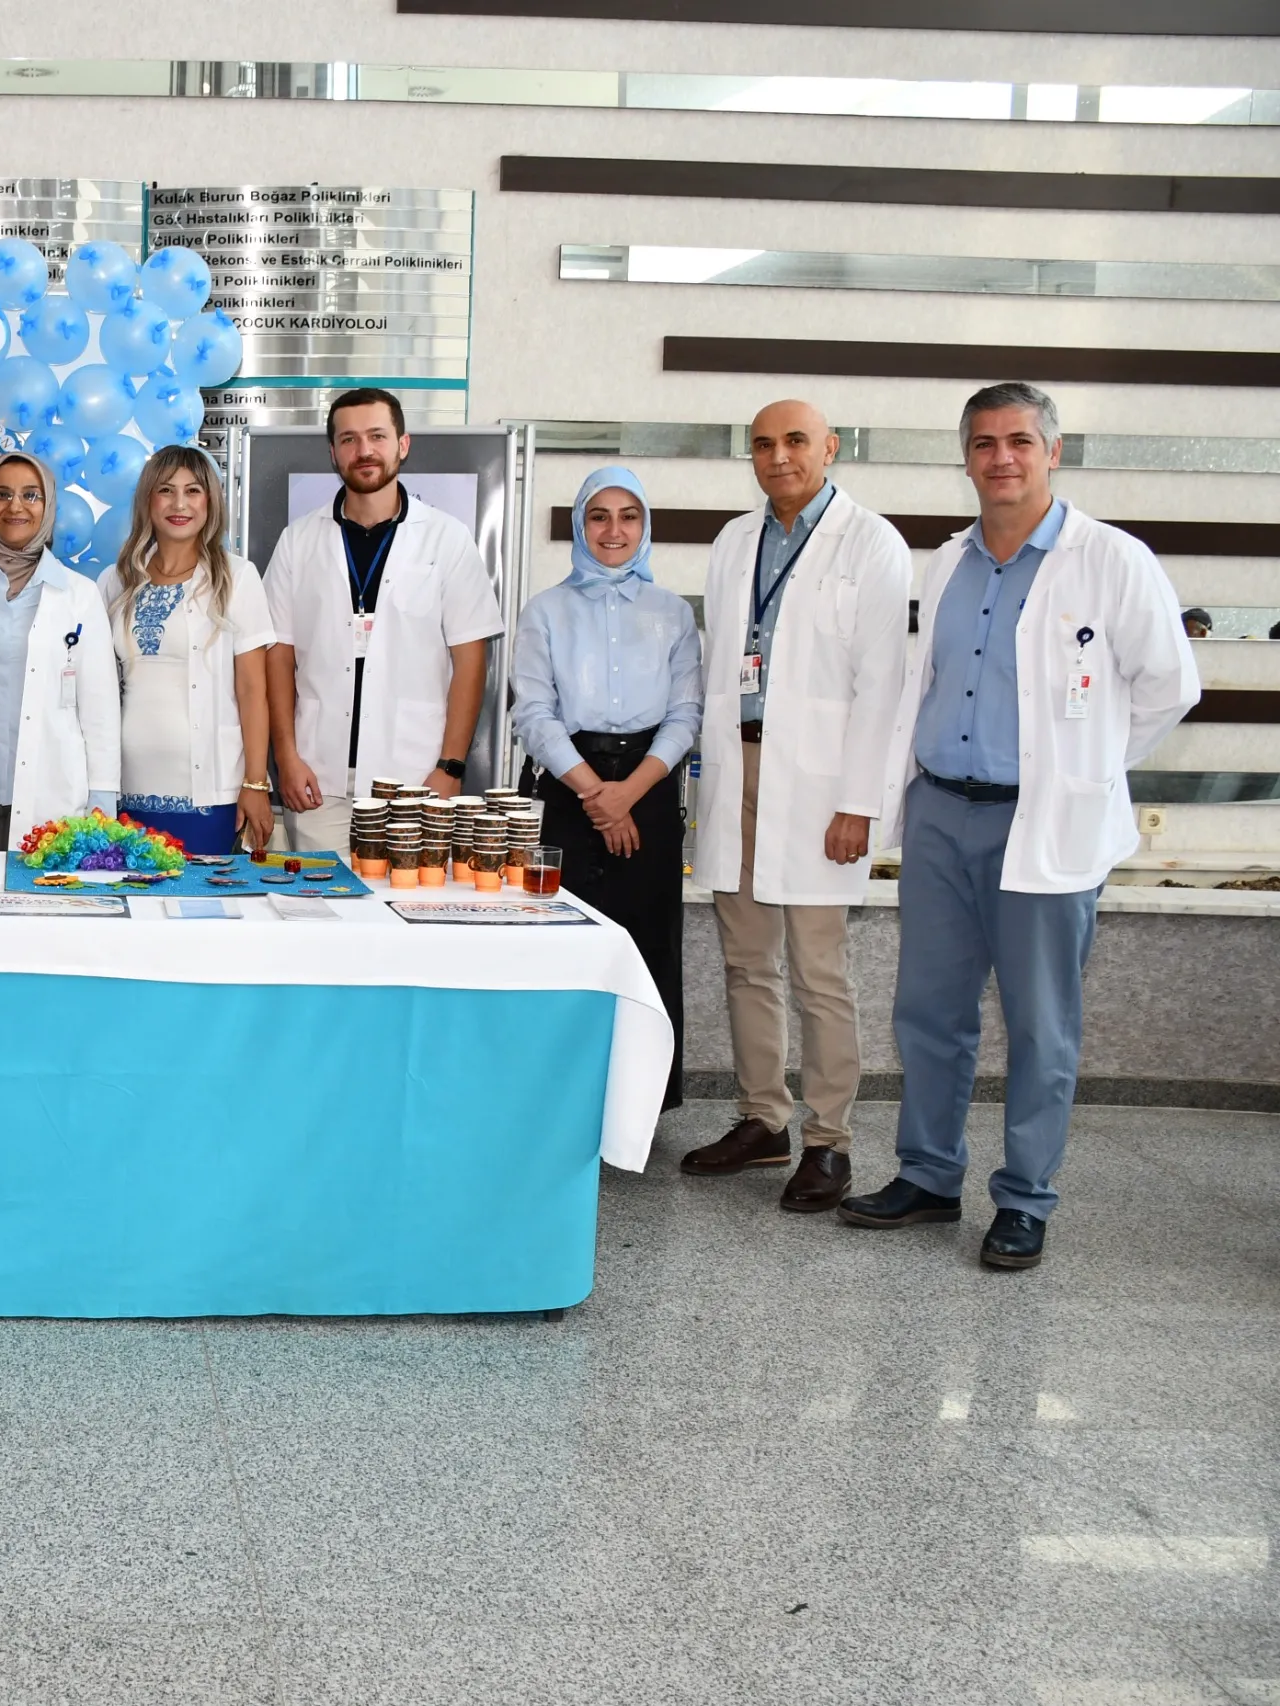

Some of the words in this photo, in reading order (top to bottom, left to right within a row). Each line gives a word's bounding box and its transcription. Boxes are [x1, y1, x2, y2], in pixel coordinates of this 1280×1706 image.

[153, 192, 194, 205] Kulak
[199, 191, 244, 203] Burun
[250, 190, 296, 204] Boğaz
[301, 190, 391, 203] Poliklinikleri
[153, 213, 182, 225] Göz
[187, 211, 269, 224] Hastalıkları
[153, 234, 202, 247] Cildiye
[207, 233, 299, 245] Poliklinikleri
[261, 256, 277, 265] ve
[331, 254, 380, 267] Cerrahi
[384, 256, 463, 270] Poliklinikleri
[223, 275, 316, 286] Poliklinikleri
[204, 297, 295, 308] Poliklinikleri
[290, 315, 387, 329] KARDİYOLOJİ
[203, 414, 248, 425] Kurulu
